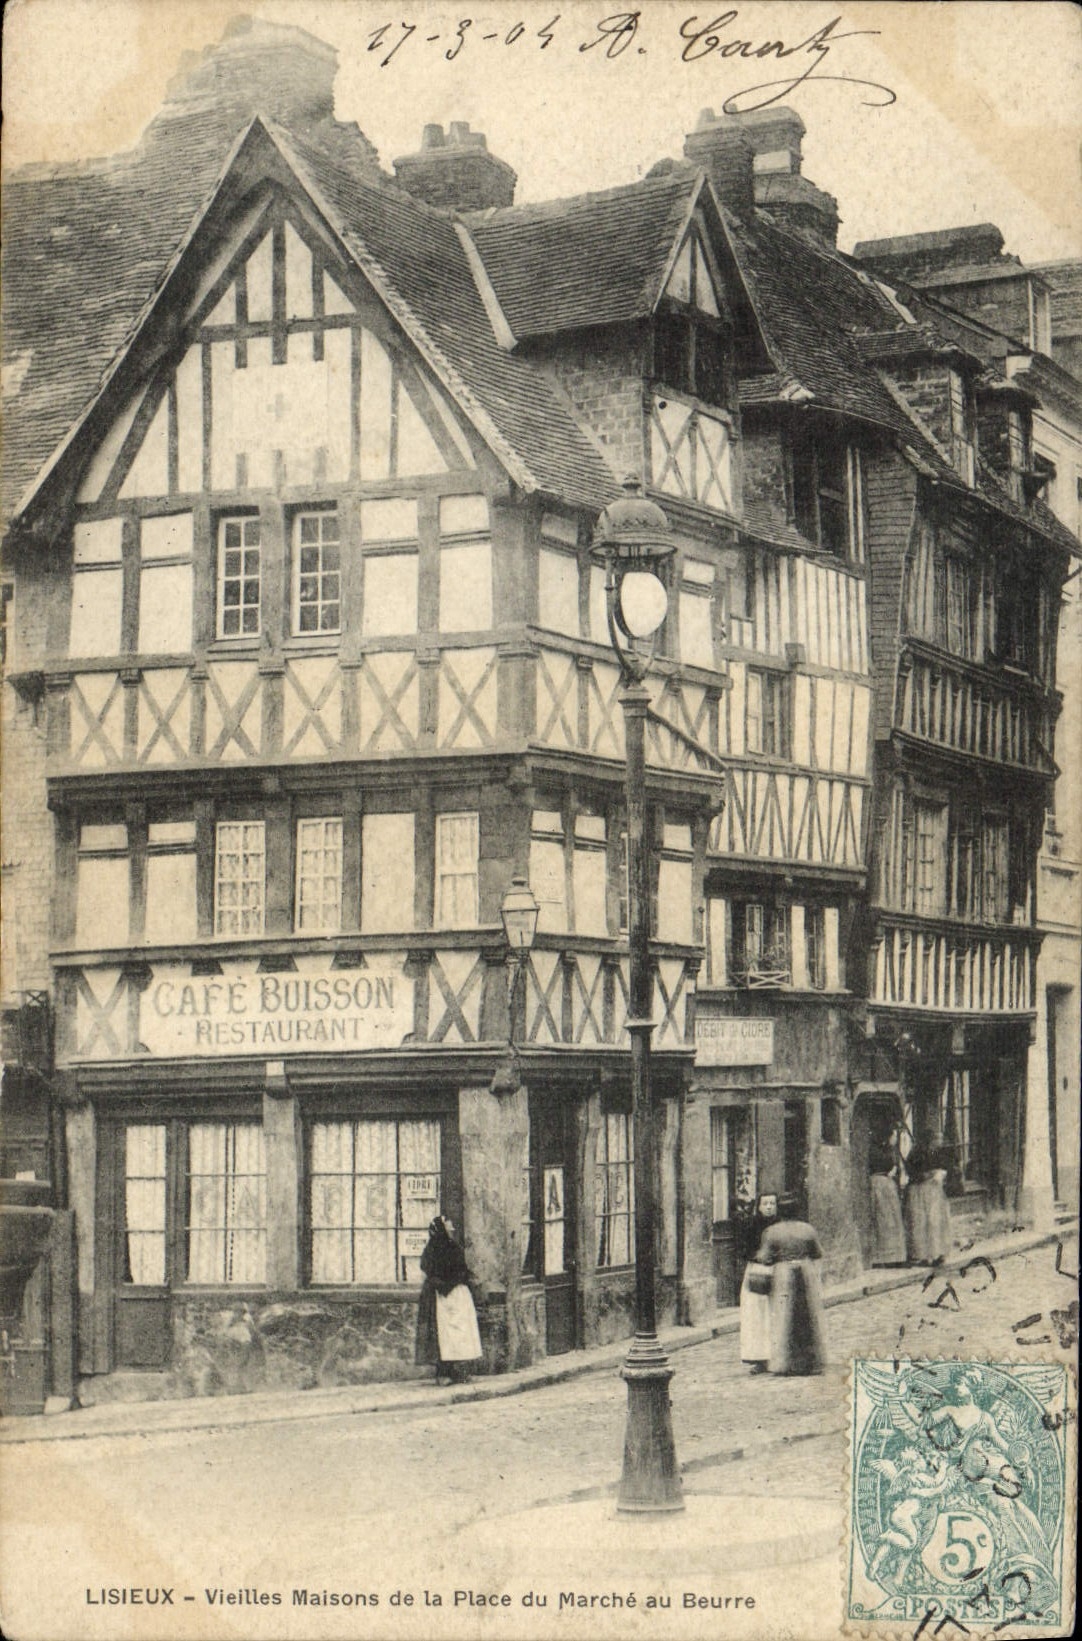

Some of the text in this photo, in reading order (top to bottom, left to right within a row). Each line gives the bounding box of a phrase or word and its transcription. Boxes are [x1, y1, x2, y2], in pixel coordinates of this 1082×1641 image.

[260, 976, 394, 1013] BUISSON
[196, 1018, 365, 1045] RESTAURANT
[910, 1597, 1000, 1619] POSTES
